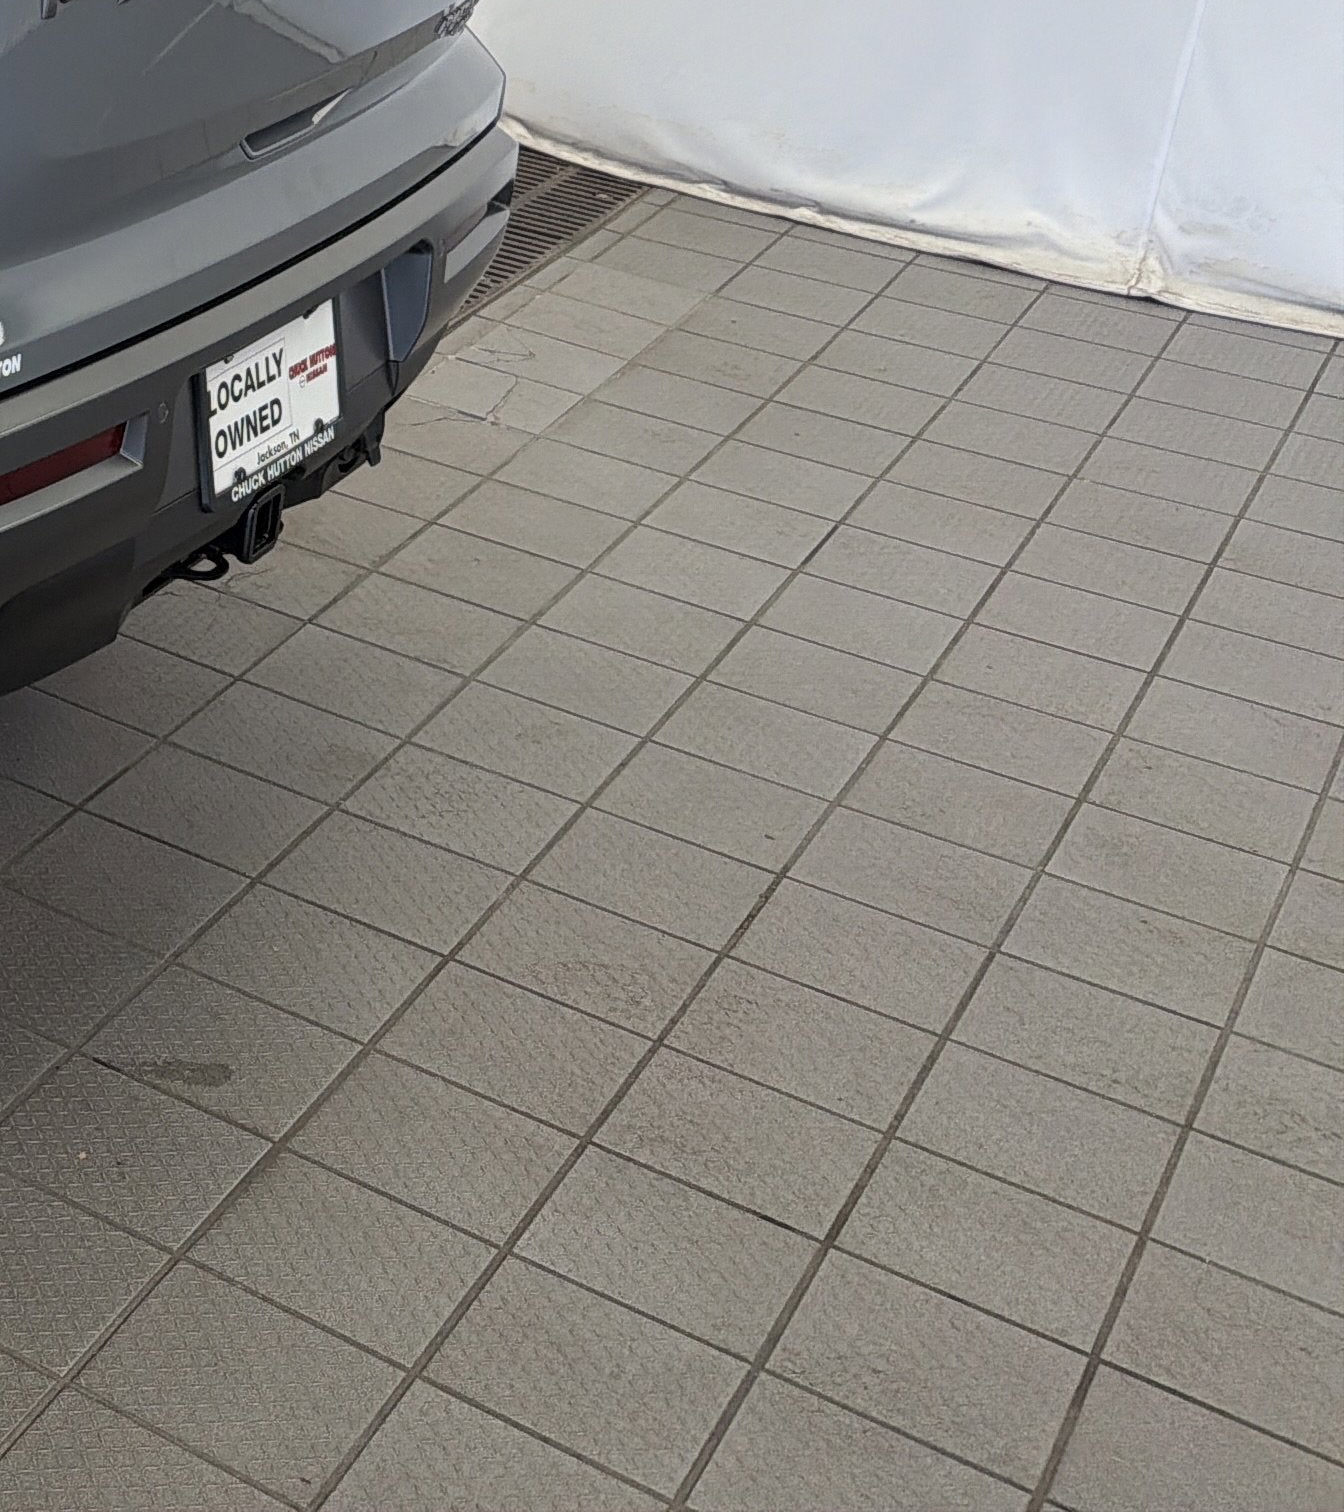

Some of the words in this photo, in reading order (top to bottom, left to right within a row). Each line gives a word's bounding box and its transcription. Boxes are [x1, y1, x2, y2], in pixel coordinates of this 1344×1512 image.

[209, 347, 284, 418] LOCALLY
[214, 397, 283, 459] OWNED
[289, 428, 301, 447] TN
[231, 471, 266, 502] CHUCK
[266, 448, 302, 481] HUTTON
[304, 426, 336, 458] NISSAN
